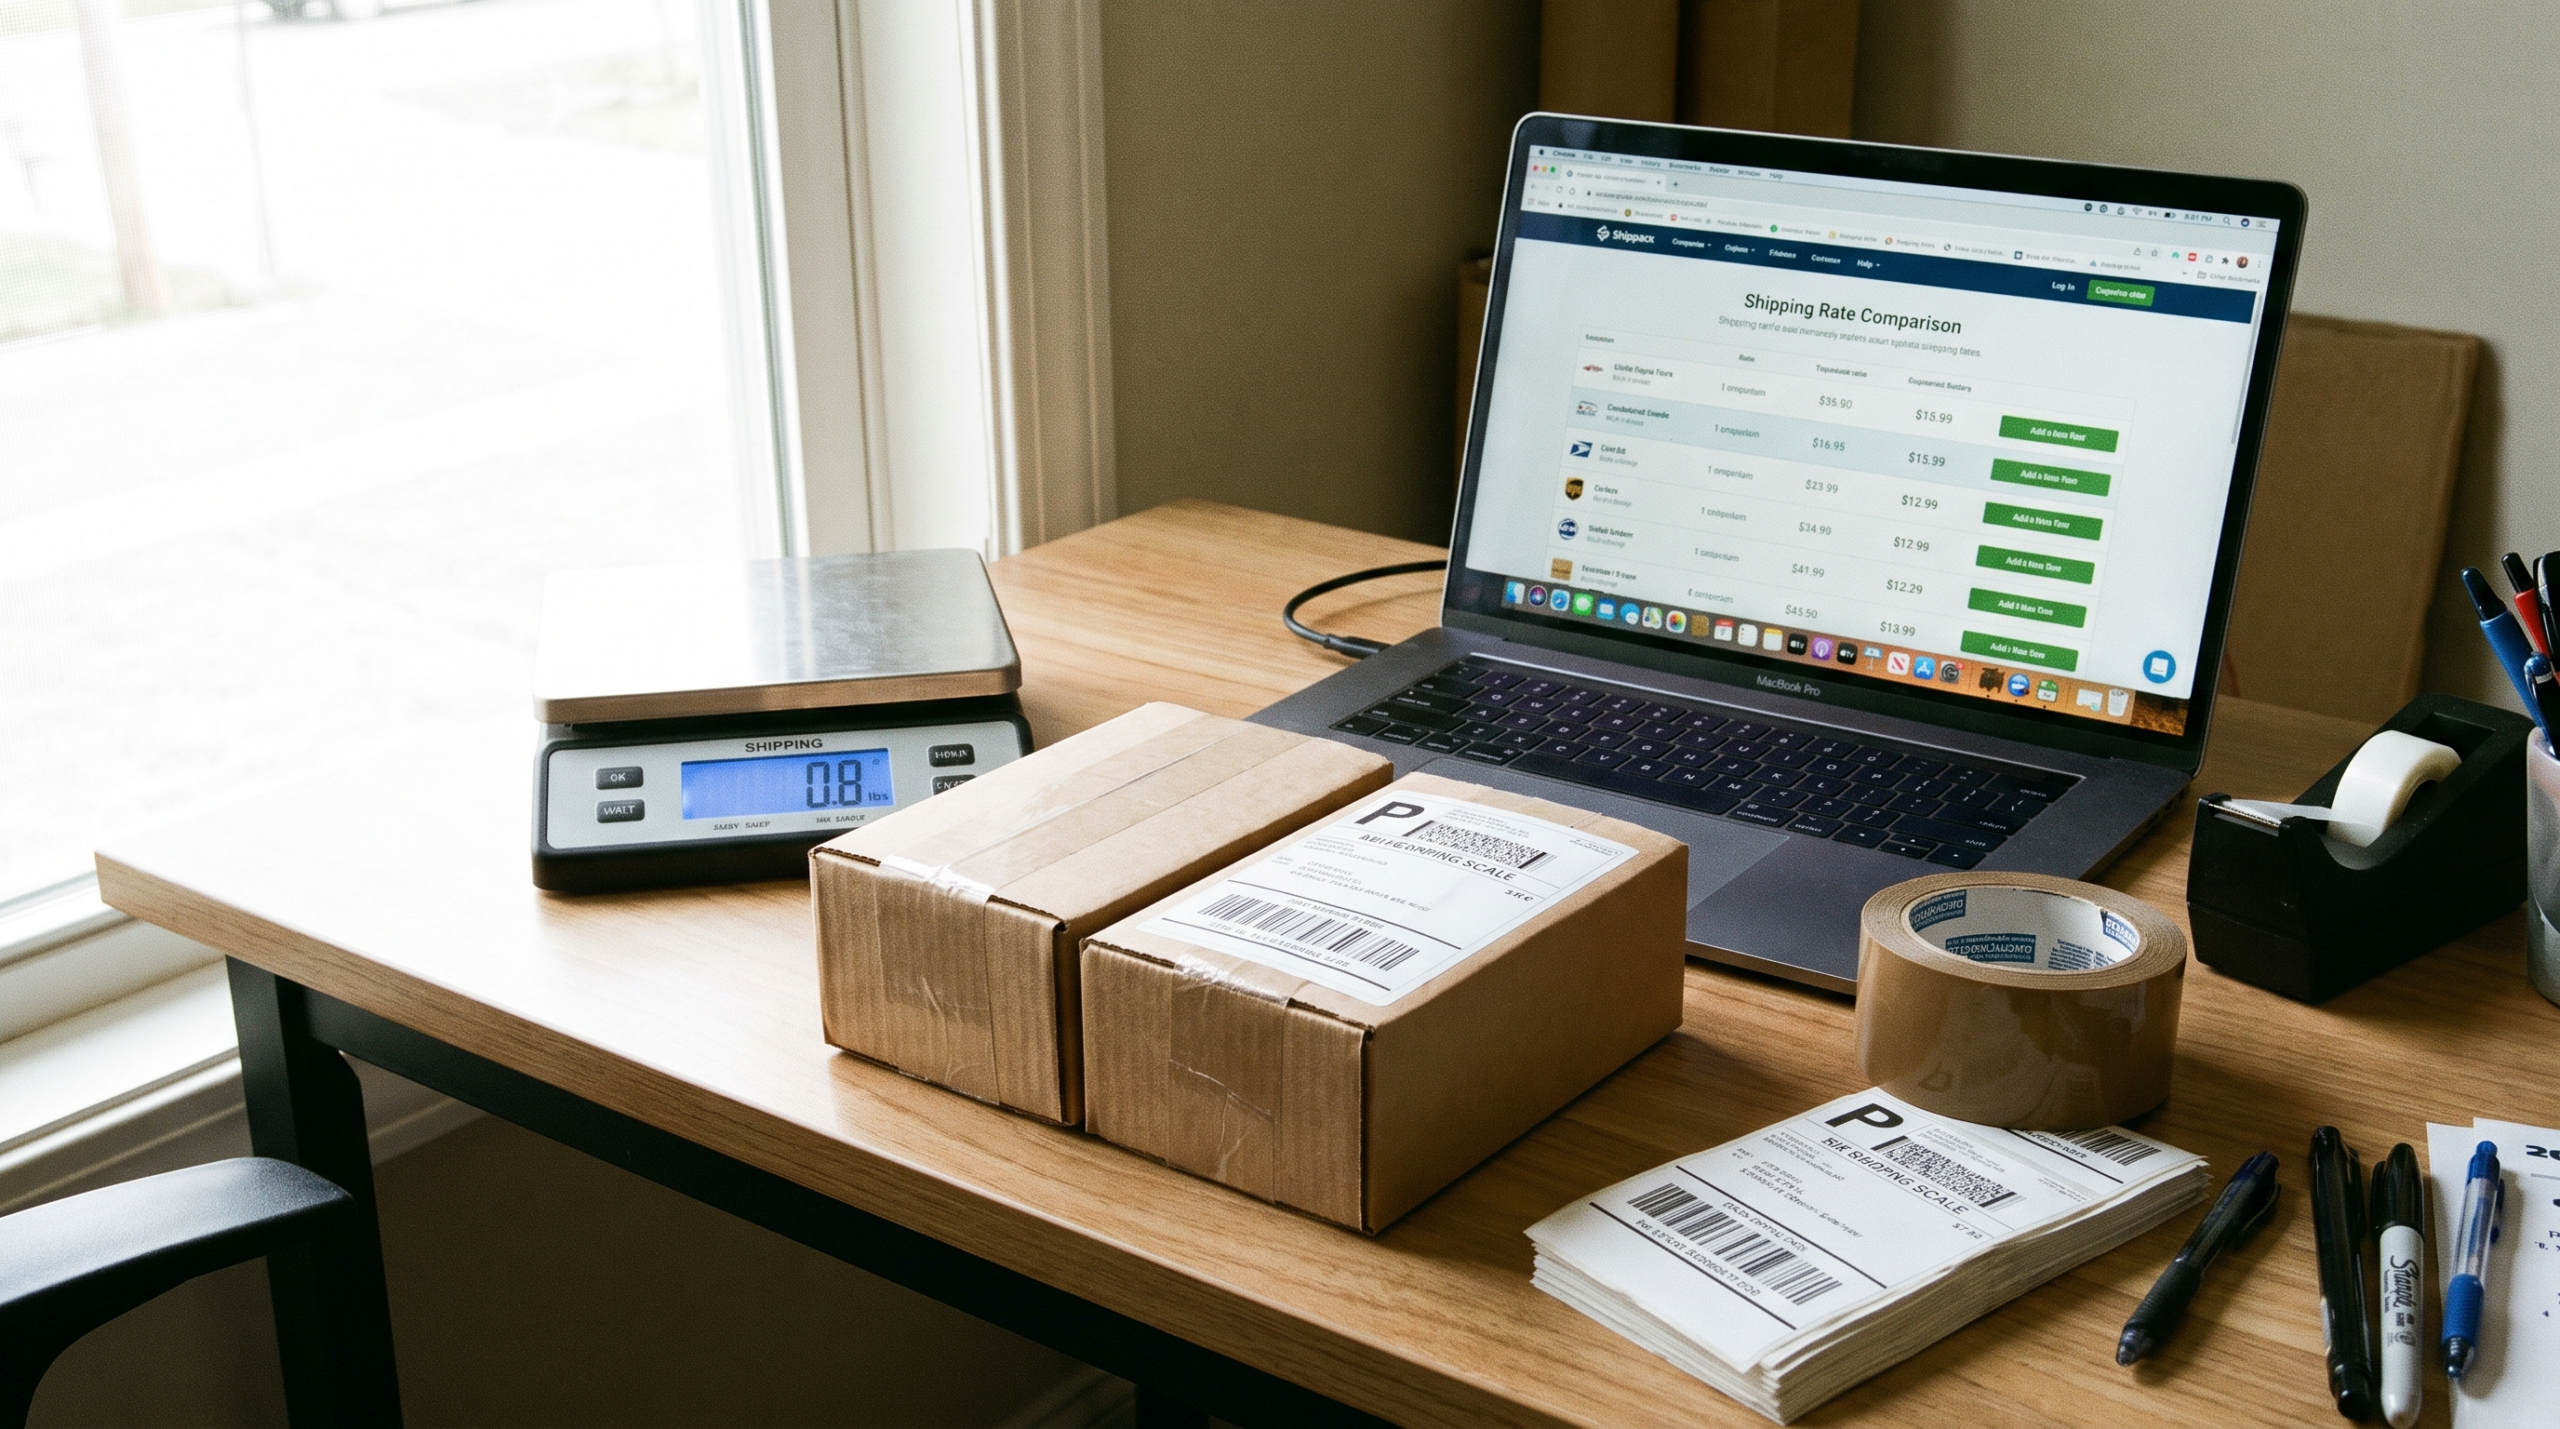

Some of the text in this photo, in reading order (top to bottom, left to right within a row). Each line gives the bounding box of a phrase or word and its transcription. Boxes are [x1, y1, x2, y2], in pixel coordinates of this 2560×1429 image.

[1612, 229, 1656, 245] Shippack
[2051, 281, 2066, 292] Log
[1744, 293, 1815, 320] Shipping
[1819, 302, 1857, 321] Rate
[1861, 307, 1963, 335] Comparison
[1915, 409, 1953, 425] $15.99
[1811, 437, 1846, 452] $16.95
[1907, 451, 1946, 467] $15.99
[1901, 494, 1939, 510] $12.99
[1893, 536, 1930, 552] $12.99
[1791, 563, 1825, 578] $41.99
[1886, 579, 1923, 595] $12.29
[1879, 621, 1916, 637] $13.99
[1756, 674, 1821, 697] MacBook Pro
[745, 738, 823, 753] SHIPPING
[610, 772, 626, 782] OK
[806, 759, 862, 808] 0.8
[868, 791, 889, 802] lbs
[603, 805, 636, 815] WALT
[1354, 801, 1425, 825] P
[1462, 859, 1518, 882] SCALE
[1824, 1102, 1904, 1129] P
[1911, 1184, 1970, 1216] SCALE
